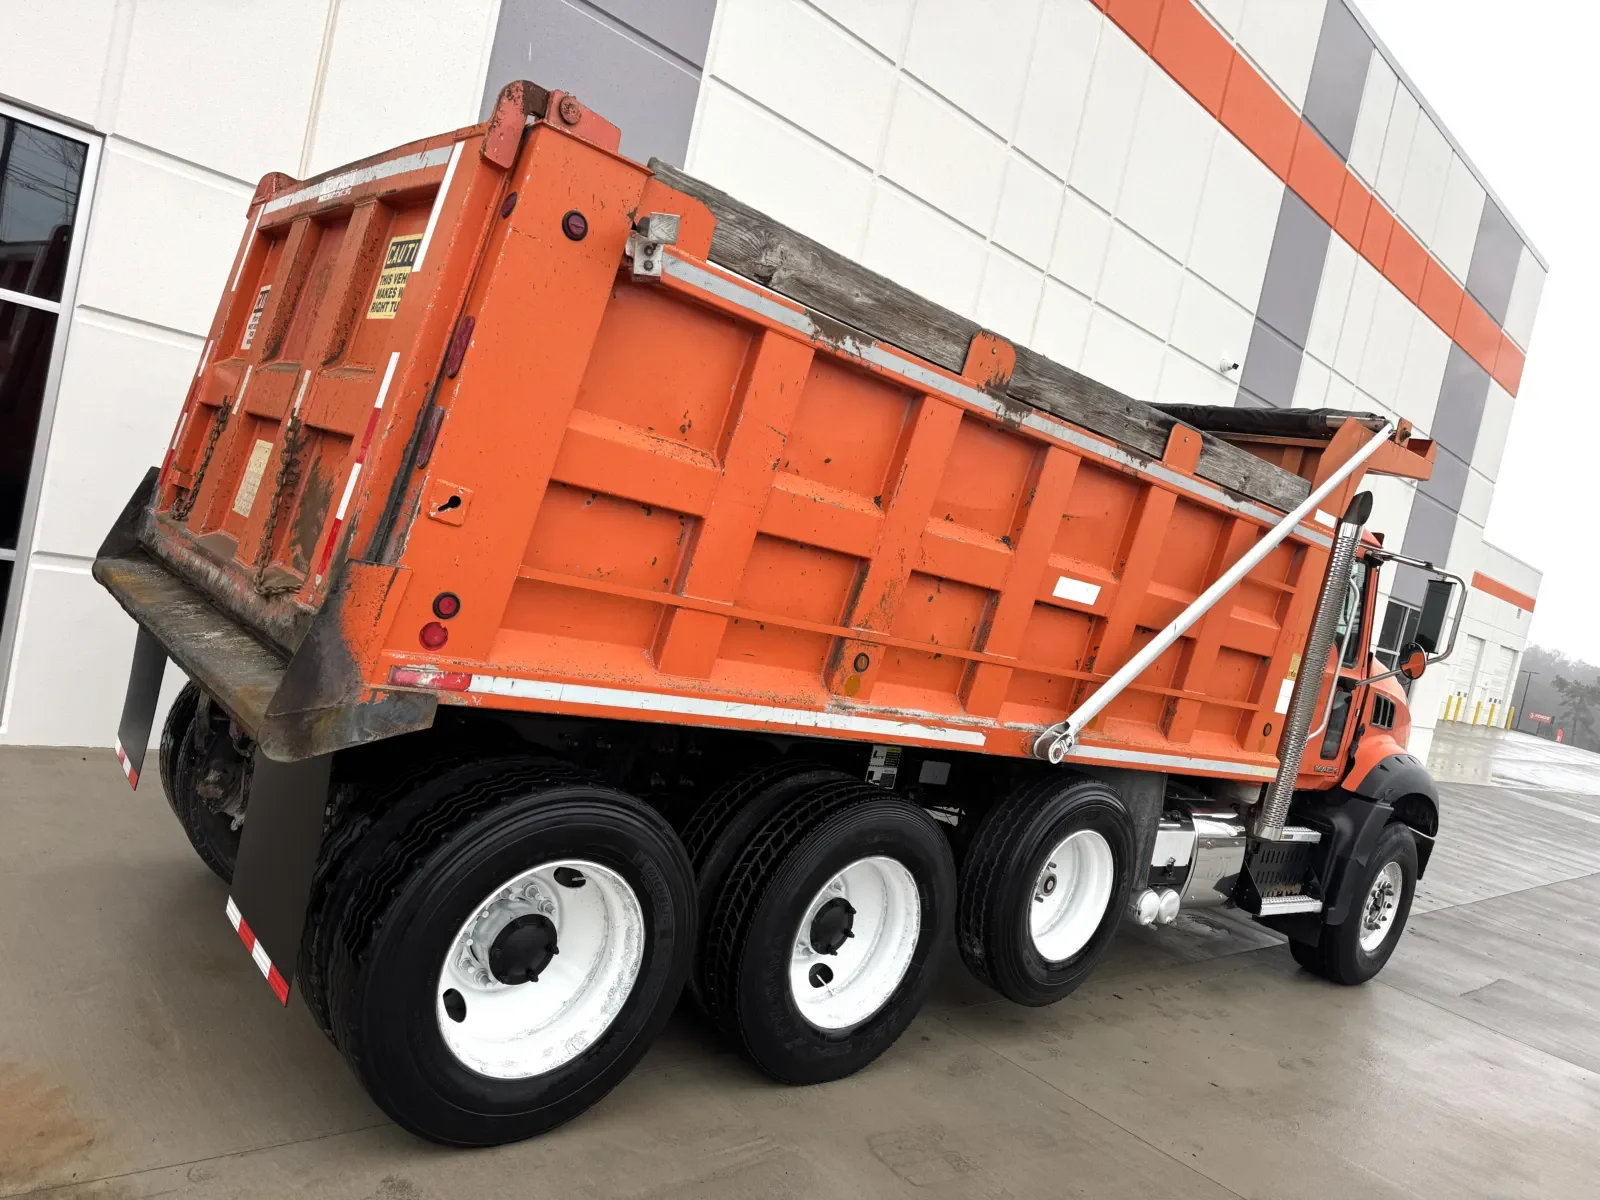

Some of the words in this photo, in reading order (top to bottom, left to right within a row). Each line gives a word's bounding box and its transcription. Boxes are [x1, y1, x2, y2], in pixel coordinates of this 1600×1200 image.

[387, 243, 418, 264] CAUTI
[380, 273, 393, 285] THIS
[394, 273, 408, 284] VEH
[376, 287, 397, 299] MAKES
[370, 302, 389, 313] RIGHT
[1314, 765, 1338, 773] MACK
